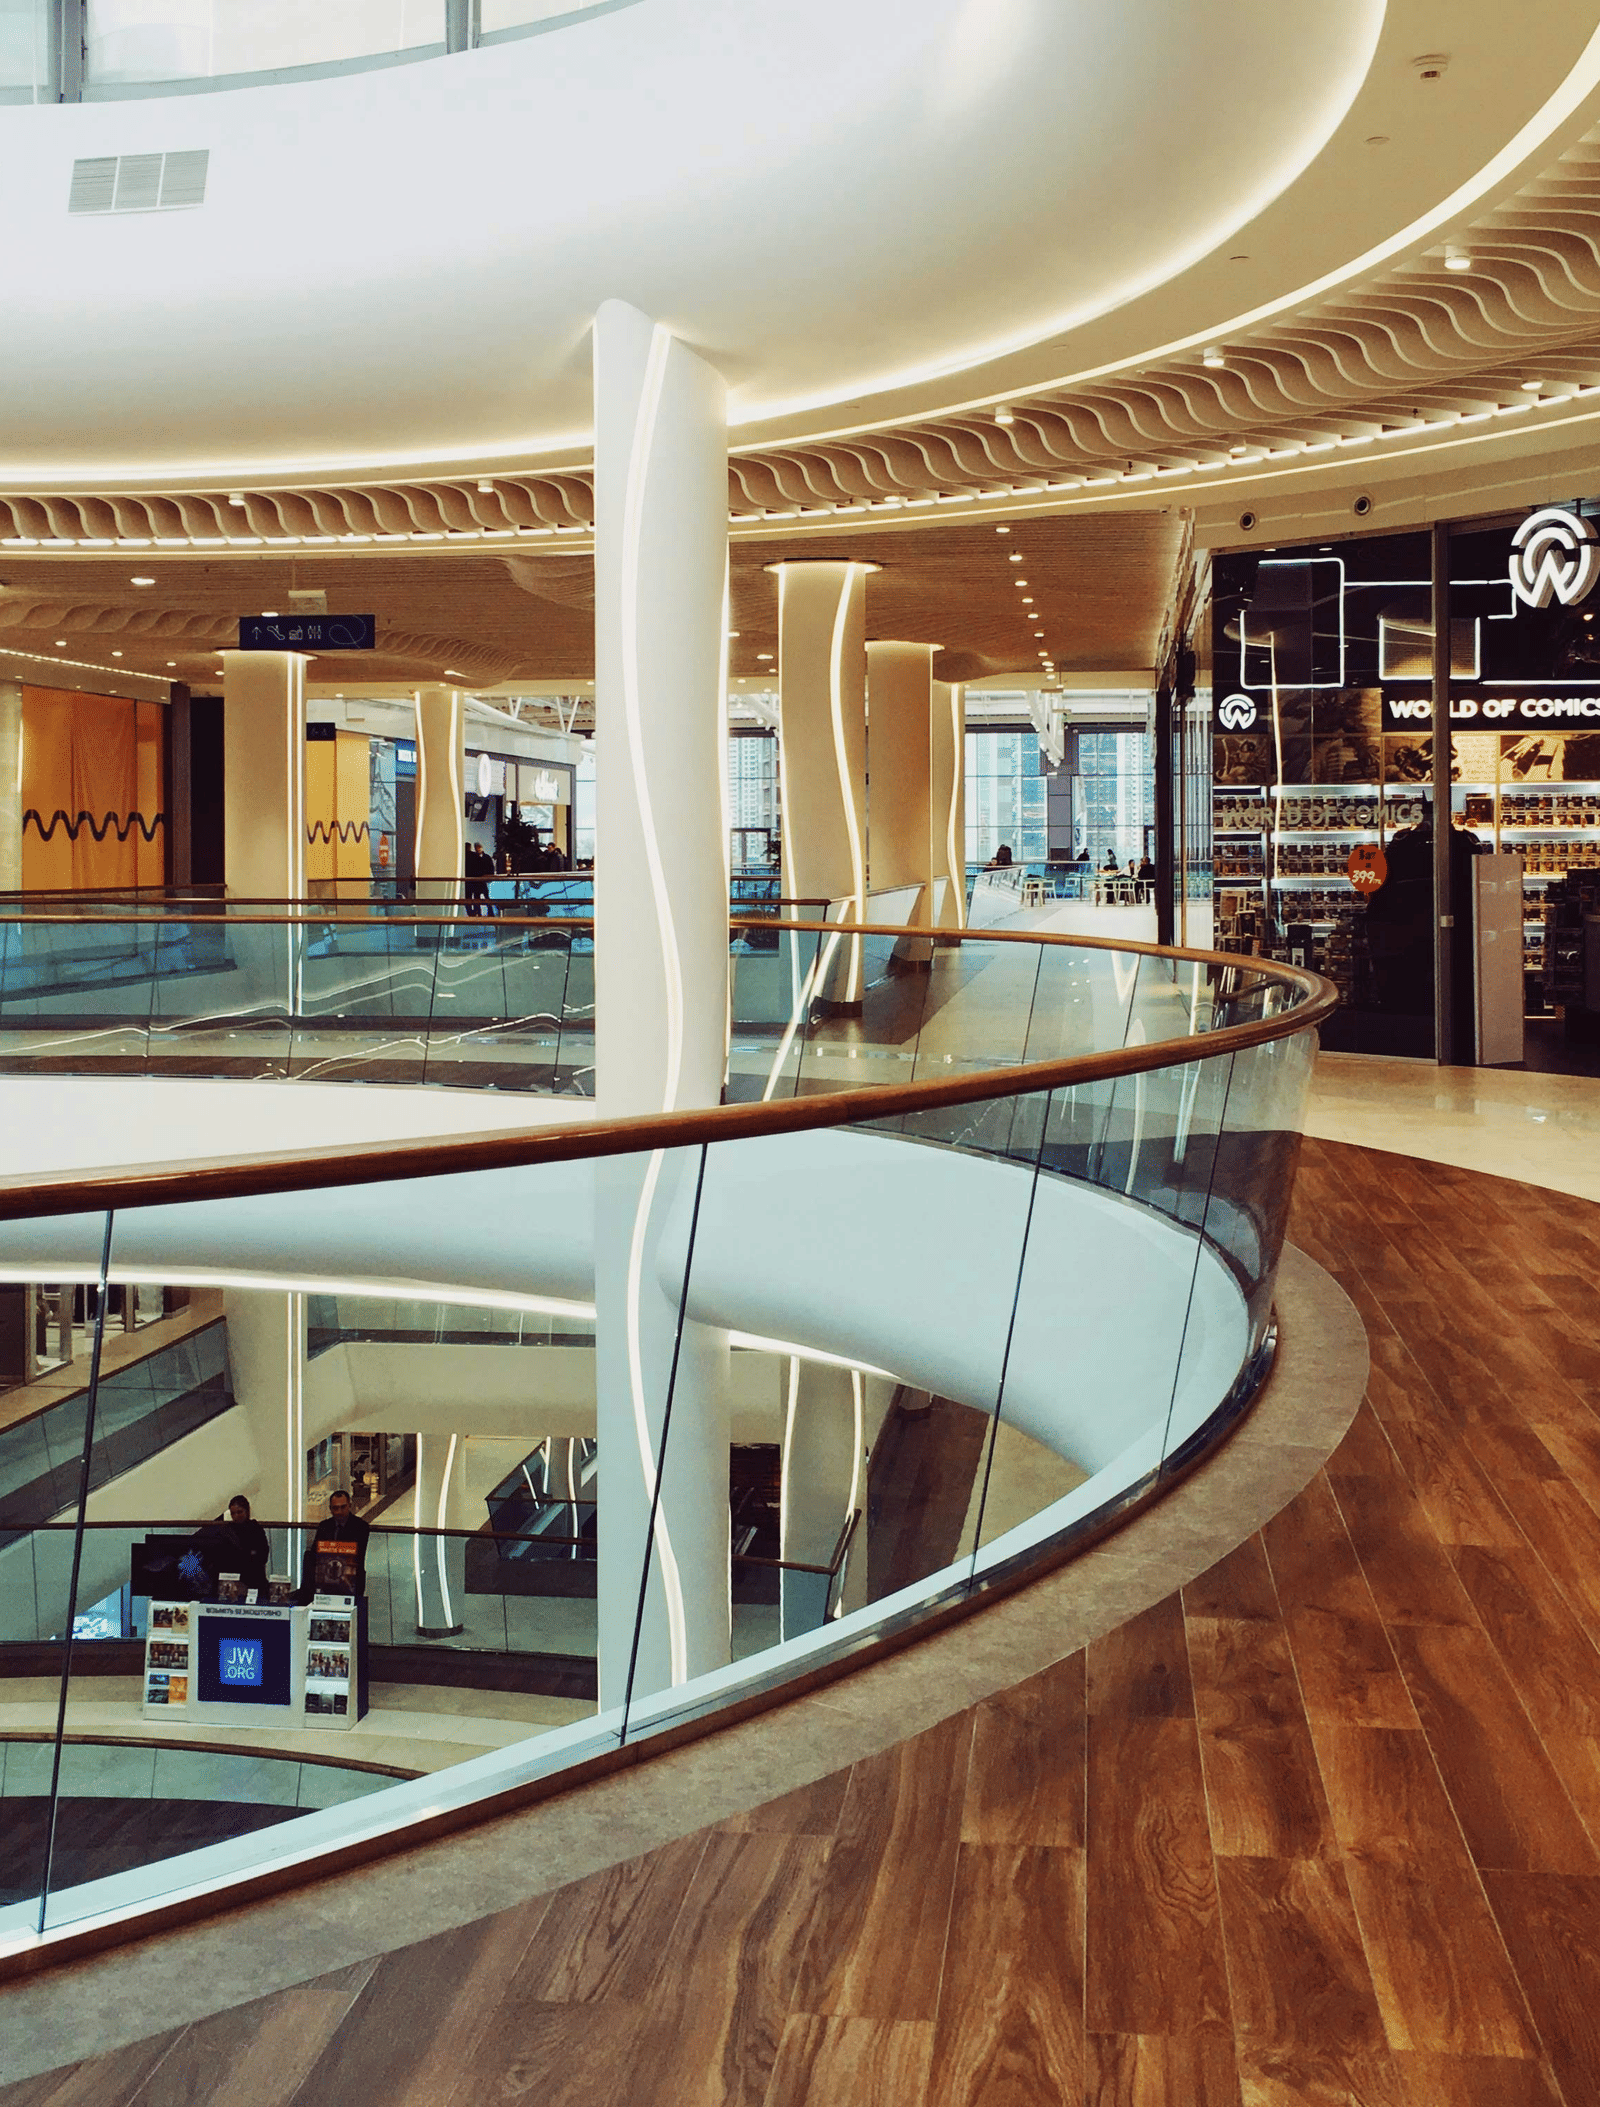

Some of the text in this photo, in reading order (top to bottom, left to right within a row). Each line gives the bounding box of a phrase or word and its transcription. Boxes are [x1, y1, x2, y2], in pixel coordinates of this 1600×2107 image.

[1389, 699, 1478, 719] WOLD
[1482, 699, 1517, 718] OF
[1308, 804, 1337, 826] OF
[1342, 803, 1424, 825] COMICS
[1351, 869, 1376, 884] 399
[226, 1646, 255, 1665] JW
[224, 1666, 255, 1680] .ORG
